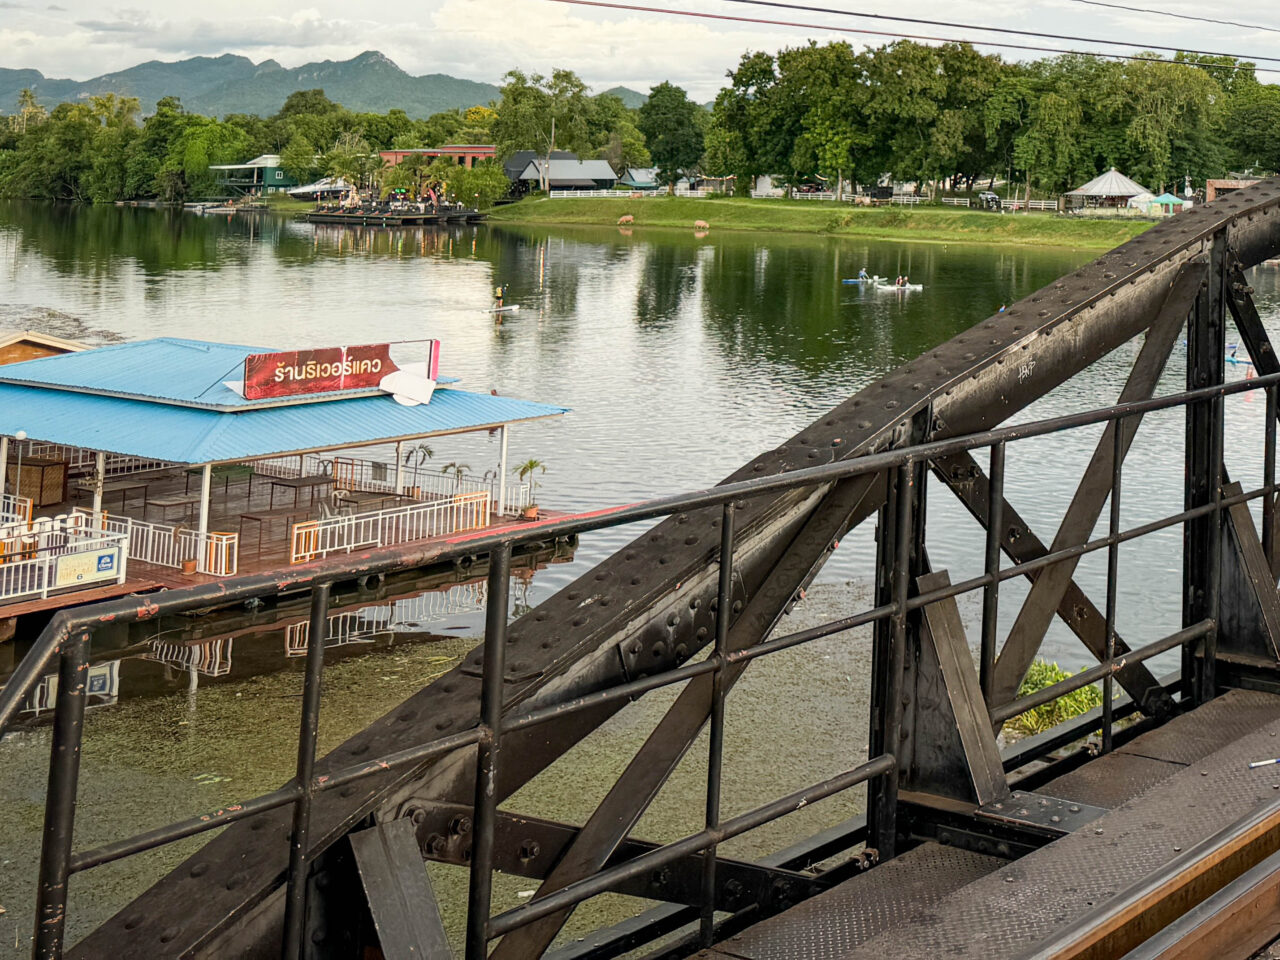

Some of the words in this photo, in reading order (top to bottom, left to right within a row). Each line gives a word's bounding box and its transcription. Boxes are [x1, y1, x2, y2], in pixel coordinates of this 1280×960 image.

[274, 355, 382, 382] ร้านริเวอร์แคว
